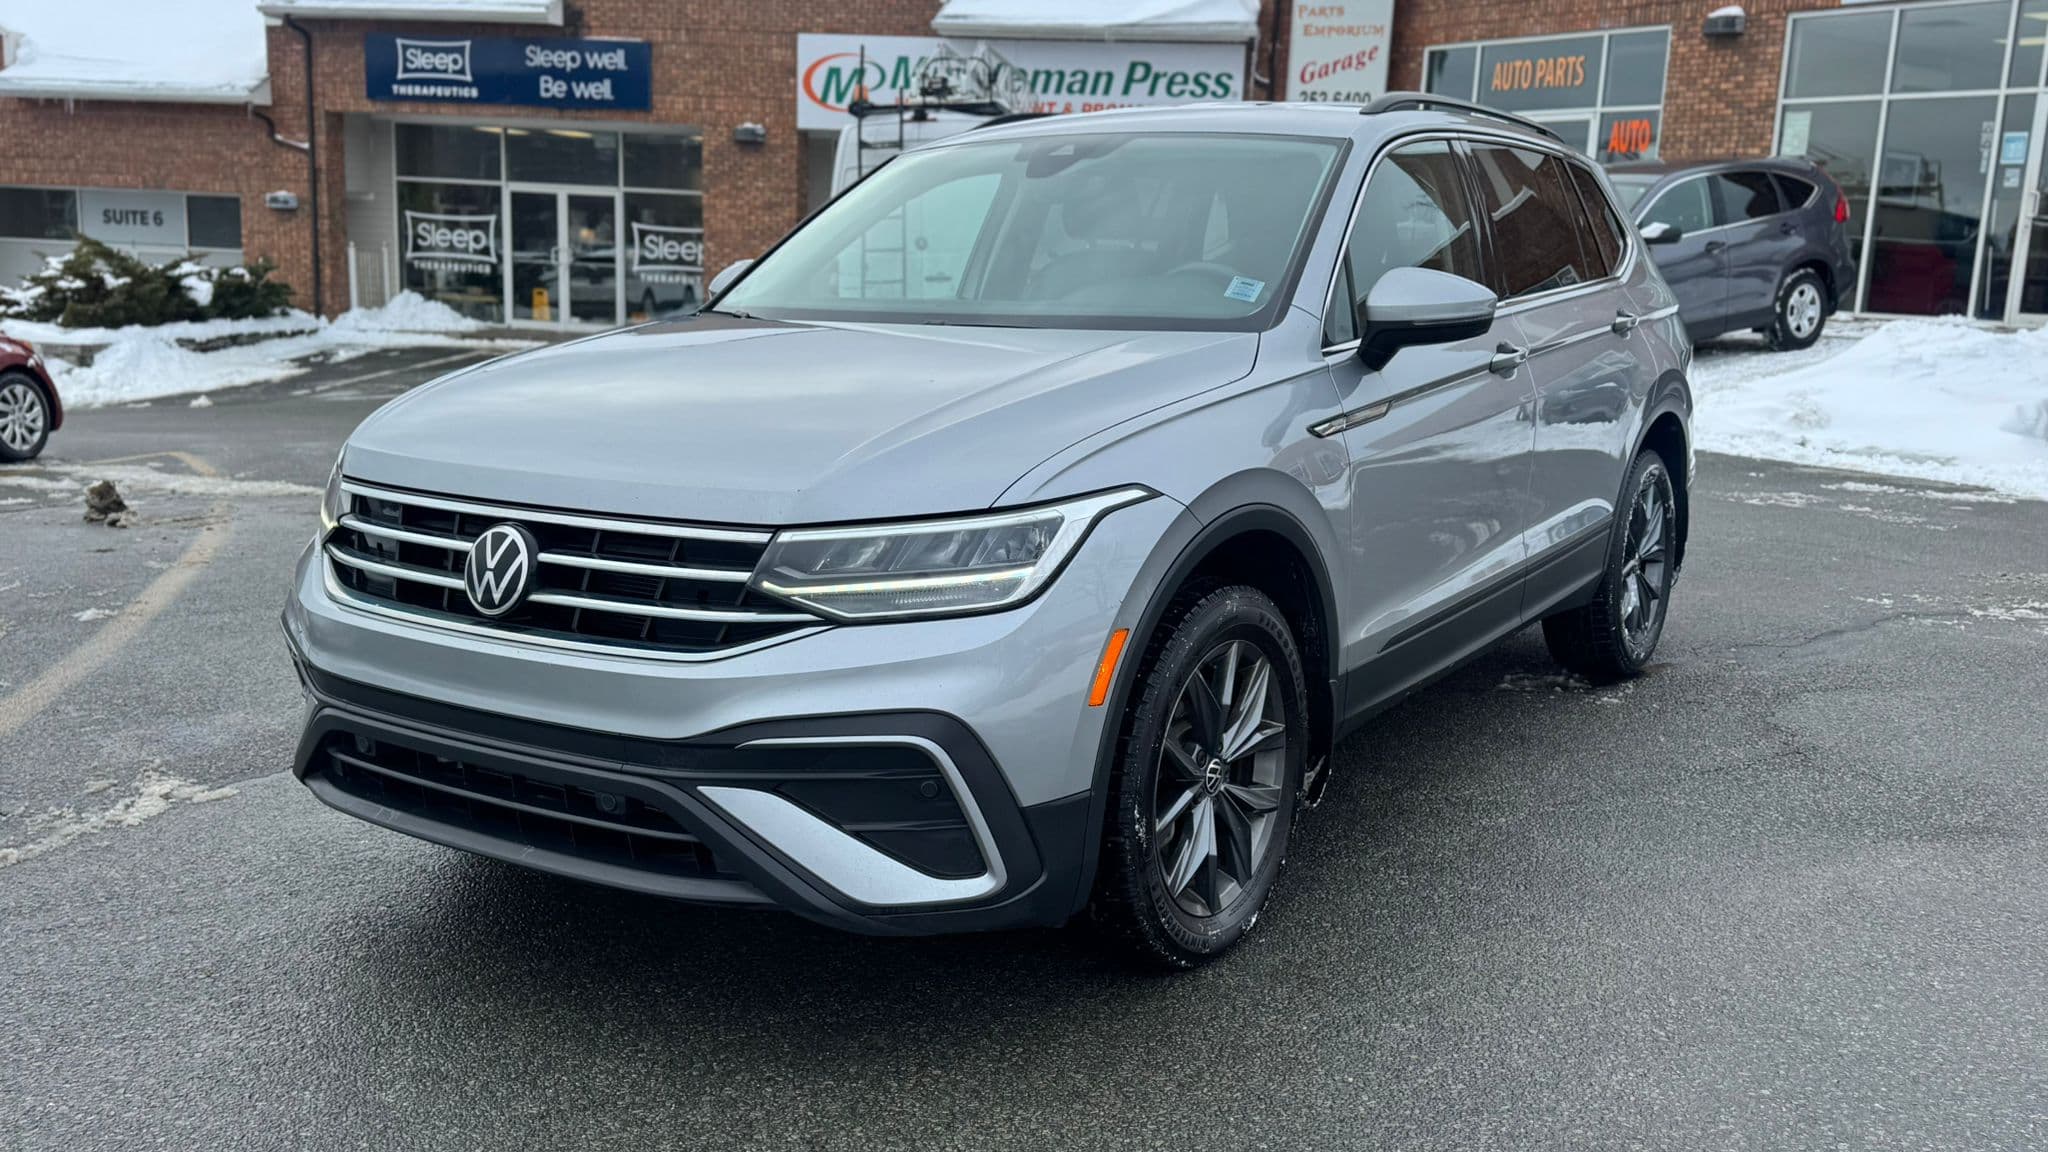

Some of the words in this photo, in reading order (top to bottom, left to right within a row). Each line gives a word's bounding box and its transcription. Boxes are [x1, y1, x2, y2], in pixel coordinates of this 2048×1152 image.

[405, 48, 463, 73] Sleep
[525, 45, 581, 72] Sleep
[1300, 44, 1379, 84] Garage
[539, 75, 568, 98] Be
[1121, 61, 1233, 98] Press
[1491, 59, 1533, 91] AUTO
[1535, 55, 1585, 89] PARTS
[392, 84, 478, 98] THERAPEUTICS
[1607, 119, 1652, 154] AUTO
[102, 208, 149, 226] SUITE
[153, 210, 164, 227] 6
[416, 222, 486, 252] Sleep
